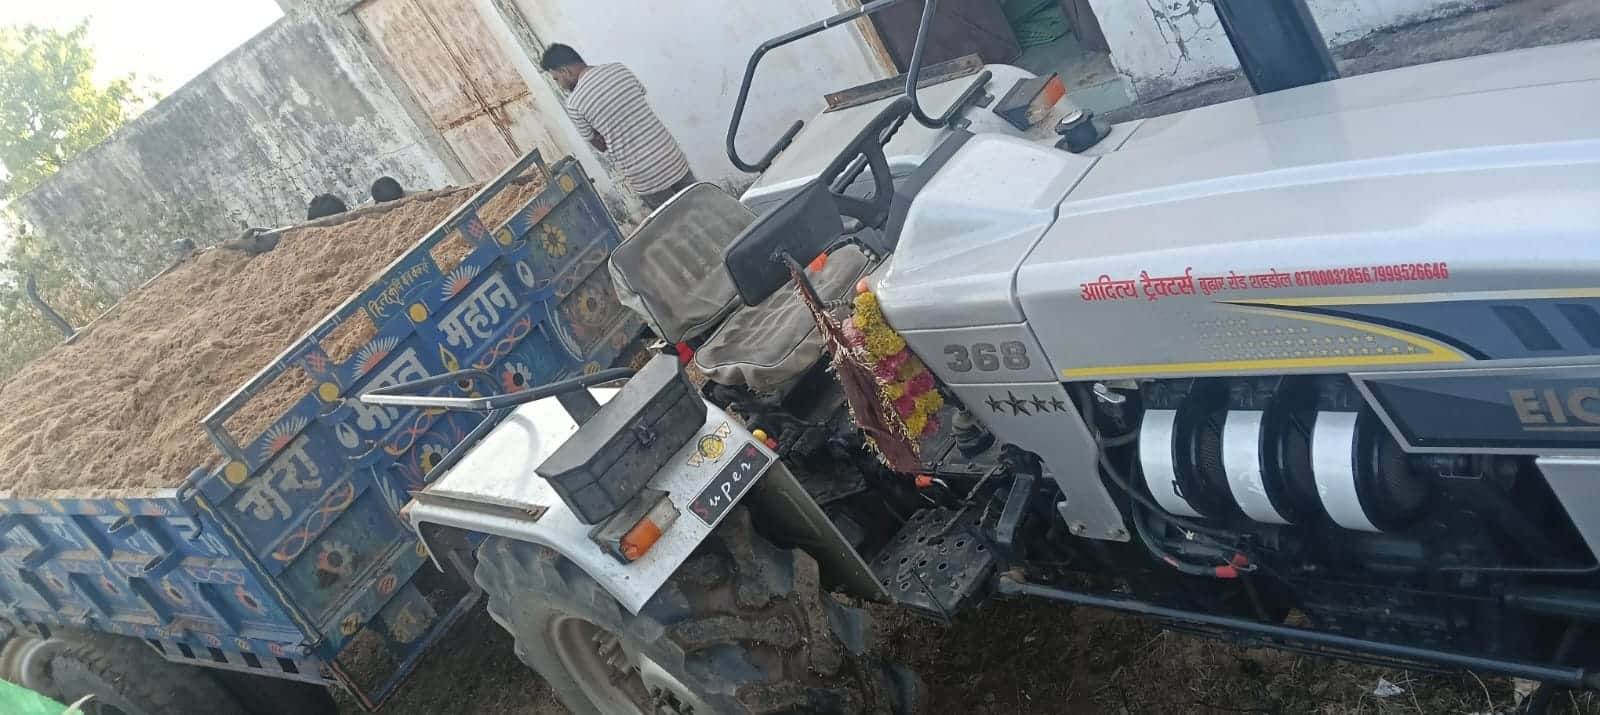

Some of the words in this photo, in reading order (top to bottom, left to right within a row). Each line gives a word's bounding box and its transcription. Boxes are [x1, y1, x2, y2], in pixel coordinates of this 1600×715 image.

[1080, 274, 1138, 301] आदित्य
[1139, 266, 1197, 302] ट्रैक्टर्स
[1226, 270, 1248, 289] रोड
[1249, 268, 1292, 289] शहडोल
[437, 271, 518, 349] महान
[943, 340, 1031, 373] 368
[1508, 387, 1600, 425] EIC
